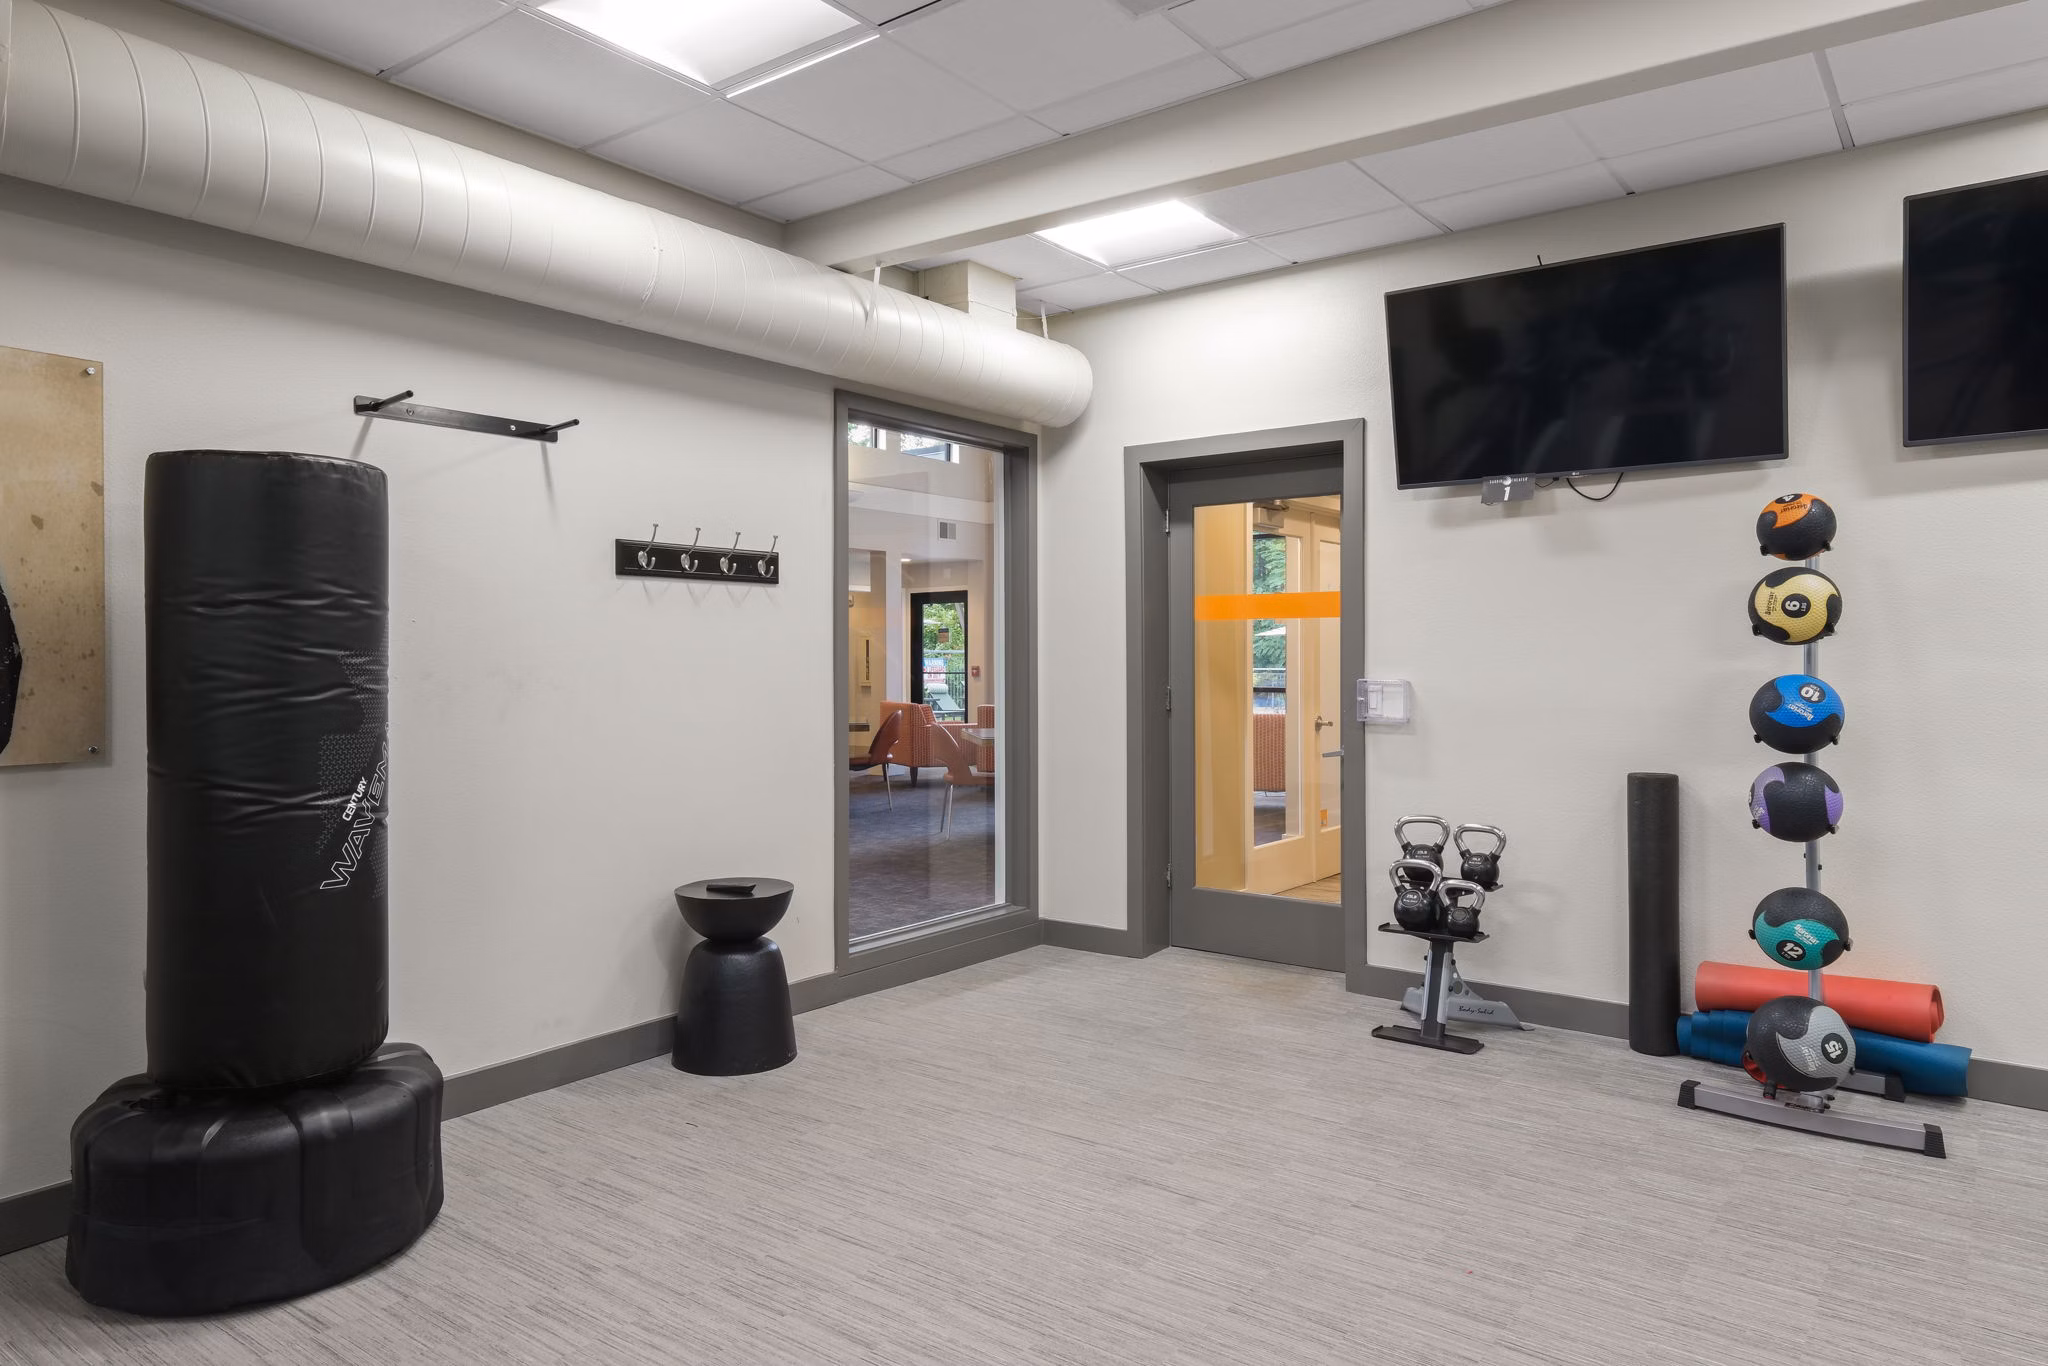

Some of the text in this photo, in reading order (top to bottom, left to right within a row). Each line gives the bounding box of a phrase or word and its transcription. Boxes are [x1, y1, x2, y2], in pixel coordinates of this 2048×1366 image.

[1503, 486, 1511, 501] 1
[1785, 600, 1800, 611] 6
[1800, 686, 1820, 701] 10
[320, 722, 389, 889] WAVEM
[342, 776, 367, 821] CENTURY
[1783, 942, 1803, 959] 12
[1824, 1040, 1842, 1059] 15
